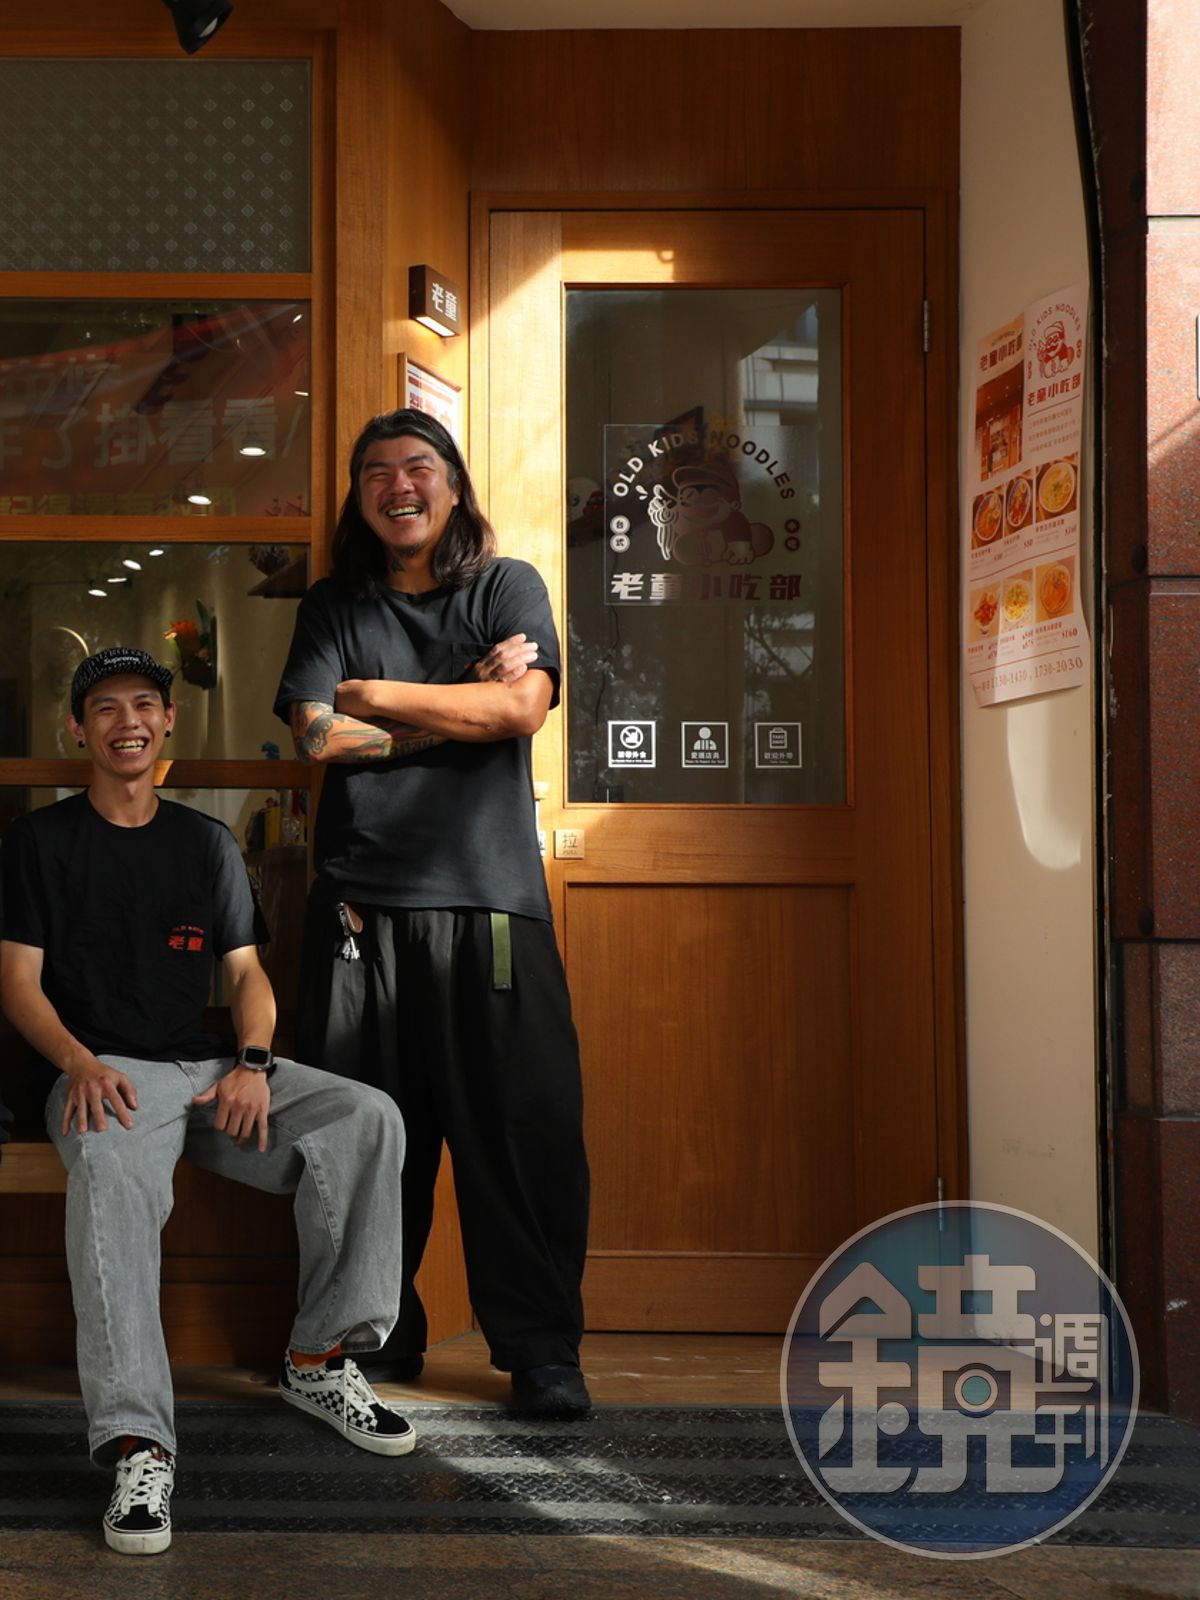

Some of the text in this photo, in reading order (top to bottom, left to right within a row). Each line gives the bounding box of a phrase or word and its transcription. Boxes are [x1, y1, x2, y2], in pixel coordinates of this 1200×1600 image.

[431, 282, 457, 322] 老童
[613, 431, 796, 500] OLD KIDS NOODLES
[611, 572, 802, 601] 老童小吃部
[562, 832, 579, 849] 拉
